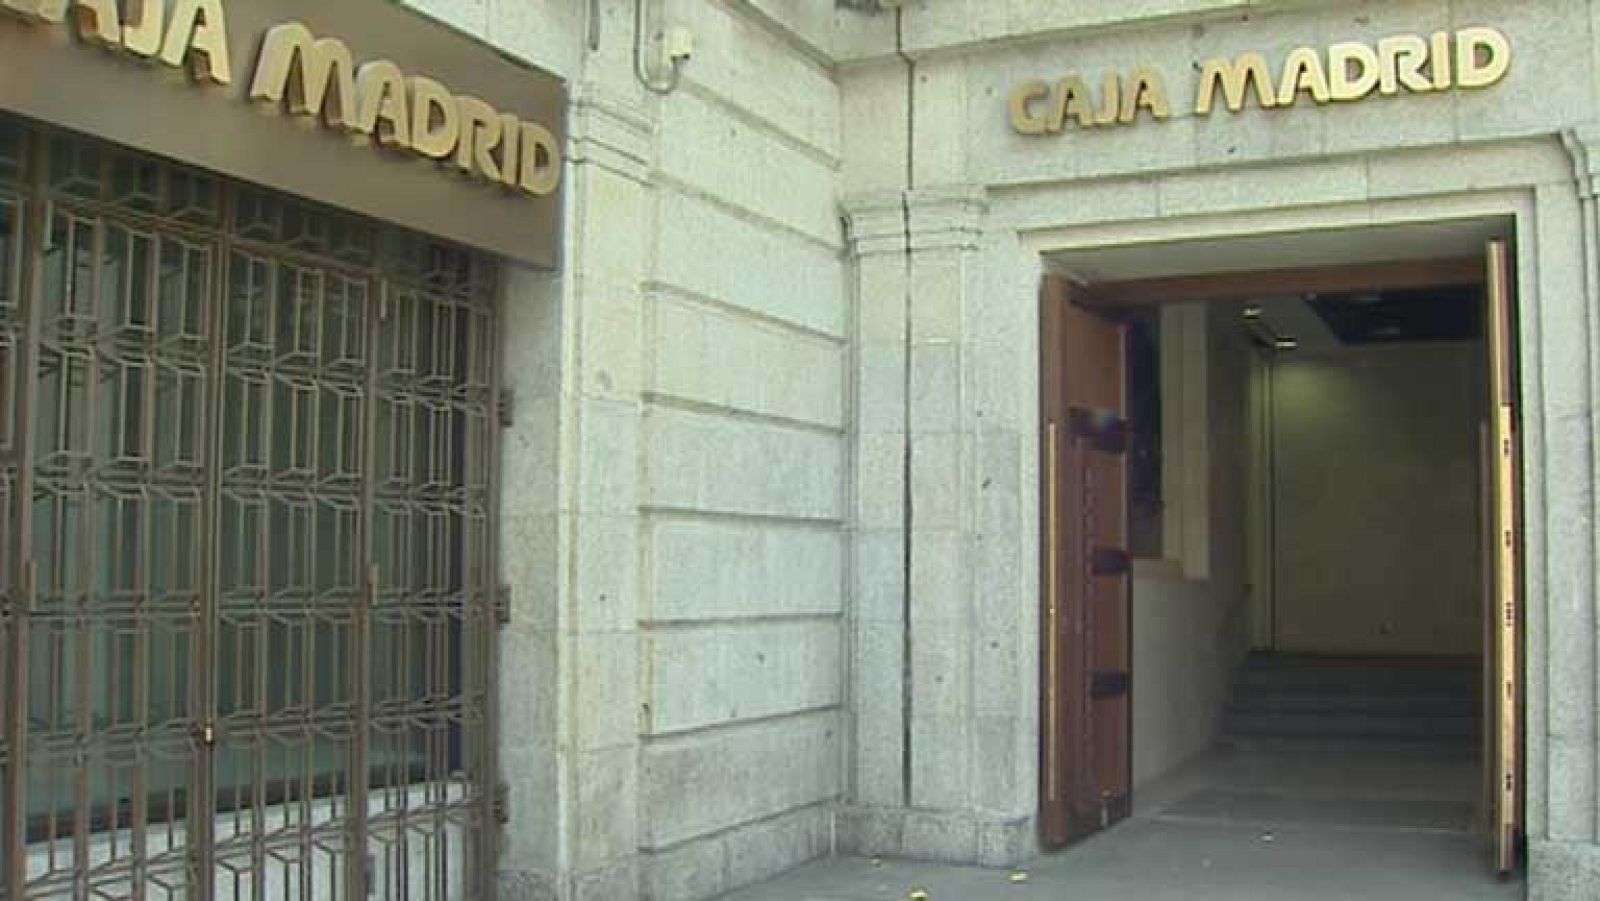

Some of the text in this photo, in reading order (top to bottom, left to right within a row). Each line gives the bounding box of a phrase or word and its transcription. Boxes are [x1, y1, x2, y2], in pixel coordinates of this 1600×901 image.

[0, 0, 559, 195] JA MADRID
[1009, 27, 1511, 135] CAJA MADRID
